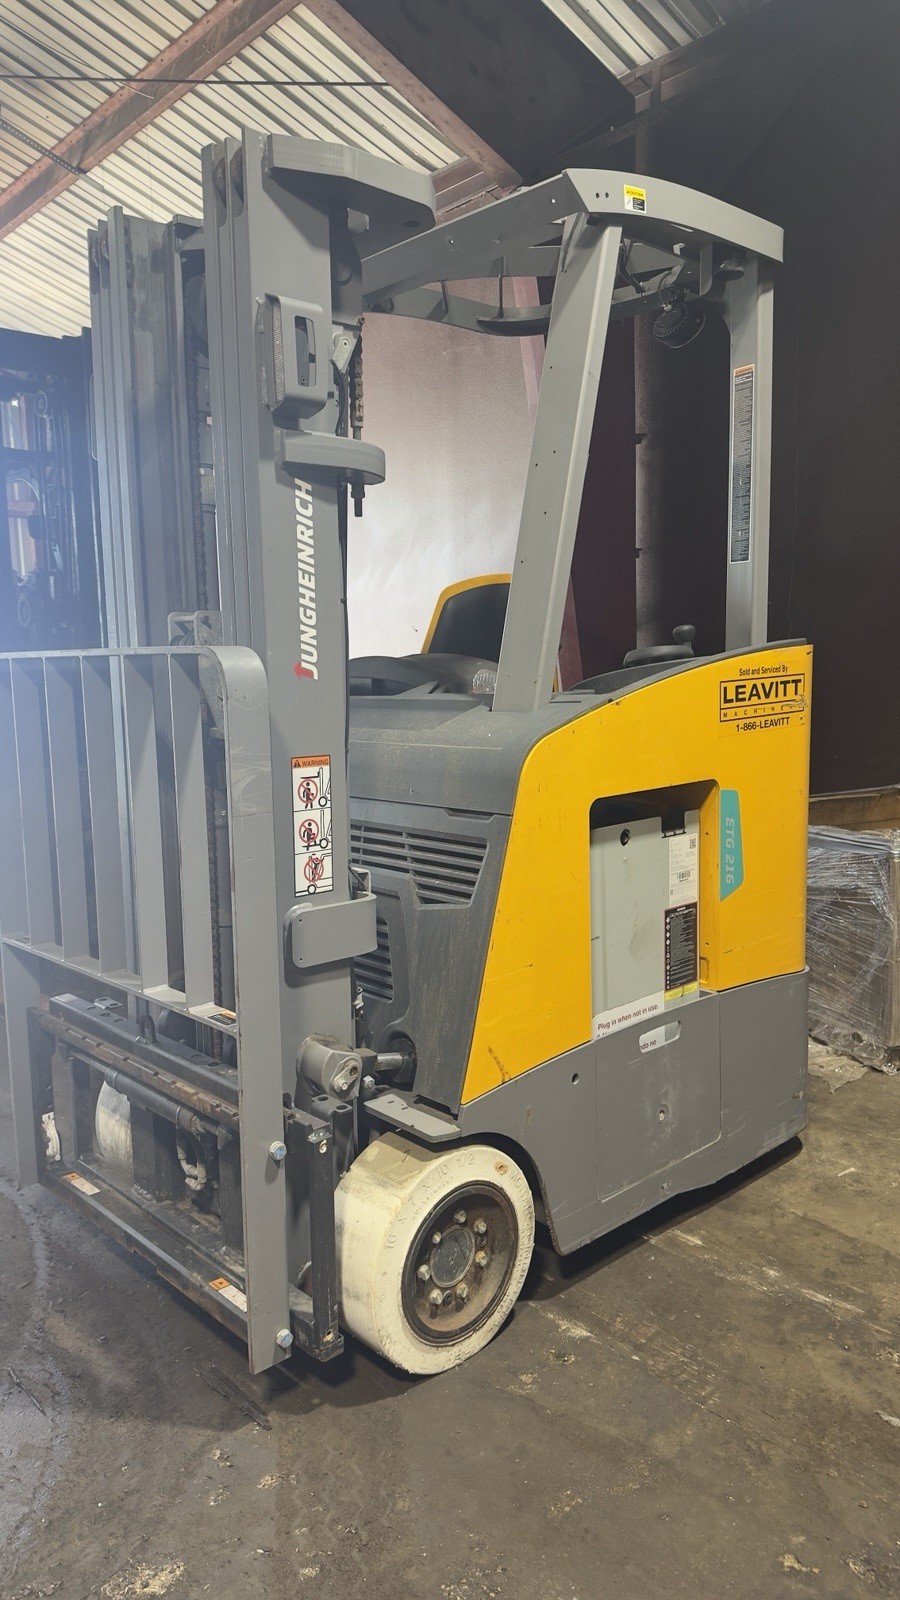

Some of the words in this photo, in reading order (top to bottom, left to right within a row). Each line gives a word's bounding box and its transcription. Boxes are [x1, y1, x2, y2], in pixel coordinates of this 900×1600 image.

[293, 477, 319, 680] JUNGHEINRICH
[739, 667, 750, 676] Sold
[751, 667, 760, 675] and
[761, 665, 781, 674] Serviced
[782, 664, 788, 674] By
[723, 679, 802, 704] LEAVITT
[723, 704, 802, 718] MACHINE
[736, 716, 790, 732] 1-866-LEAVITT
[301, 758, 329, 767] WARNING
[725, 816, 735, 849] ETG
[725, 854, 735, 884] 216
[597, 1021, 610, 1031] Plug
[611, 1018, 616, 1026] in
[617, 1013, 631, 1023] when
[633, 1009, 641, 1017] not
[640, 1042, 649, 1050] ndo
